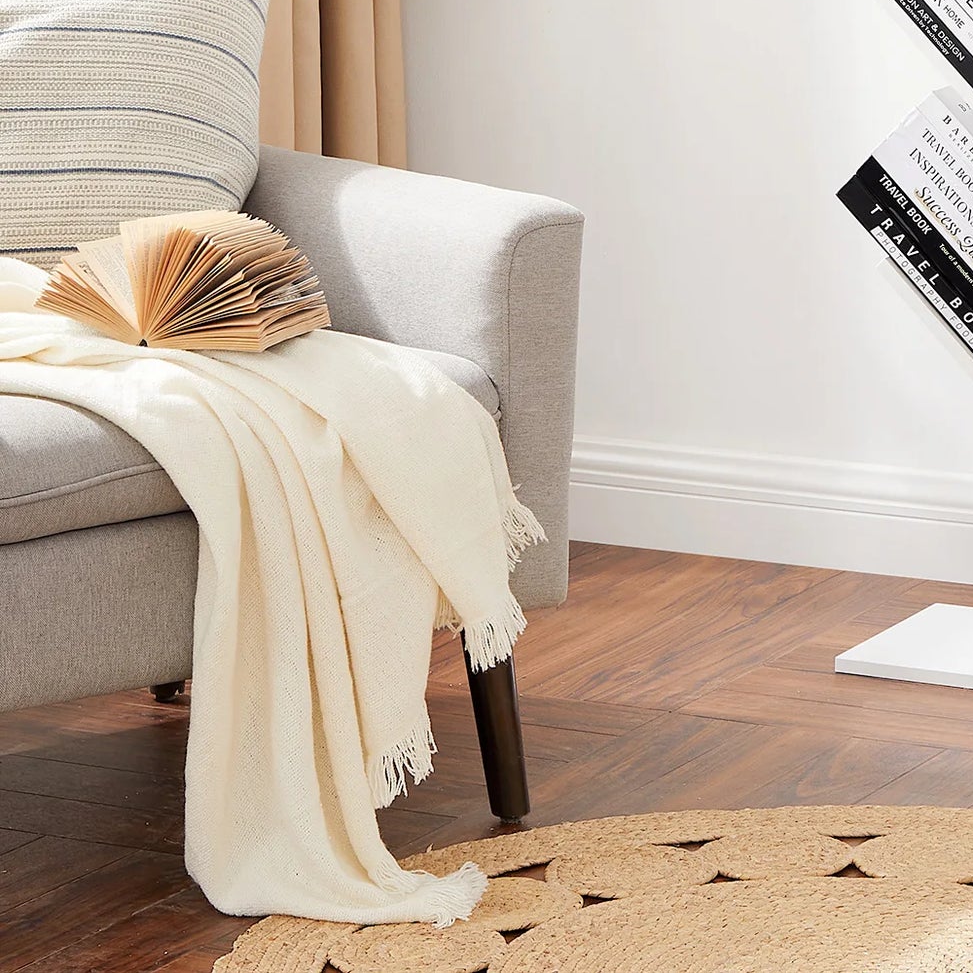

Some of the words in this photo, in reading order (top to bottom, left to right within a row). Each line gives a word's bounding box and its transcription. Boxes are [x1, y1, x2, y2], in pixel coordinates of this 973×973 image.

[905, 5, 919, 21] Driven
[924, 26, 950, 56] Technology
[917, 9, 934, 24] ART
[932, 23, 939, 32] &
[937, 29, 966, 63] DESIGN
[943, 5, 965, 29] HOME
[922, 128, 956, 170] TRAVEL
[879, 174, 909, 209] TRAVEL
[906, 207, 932, 235] BOOK
[915, 186, 961, 236] Success
[870, 203, 940, 286] TRAVEL
[939, 243, 950, 255] Tour
[948, 253, 955, 262] of
[956, 263, 973, 284] modern
[876, 231, 948, 311] PHOTOGRAPHY
